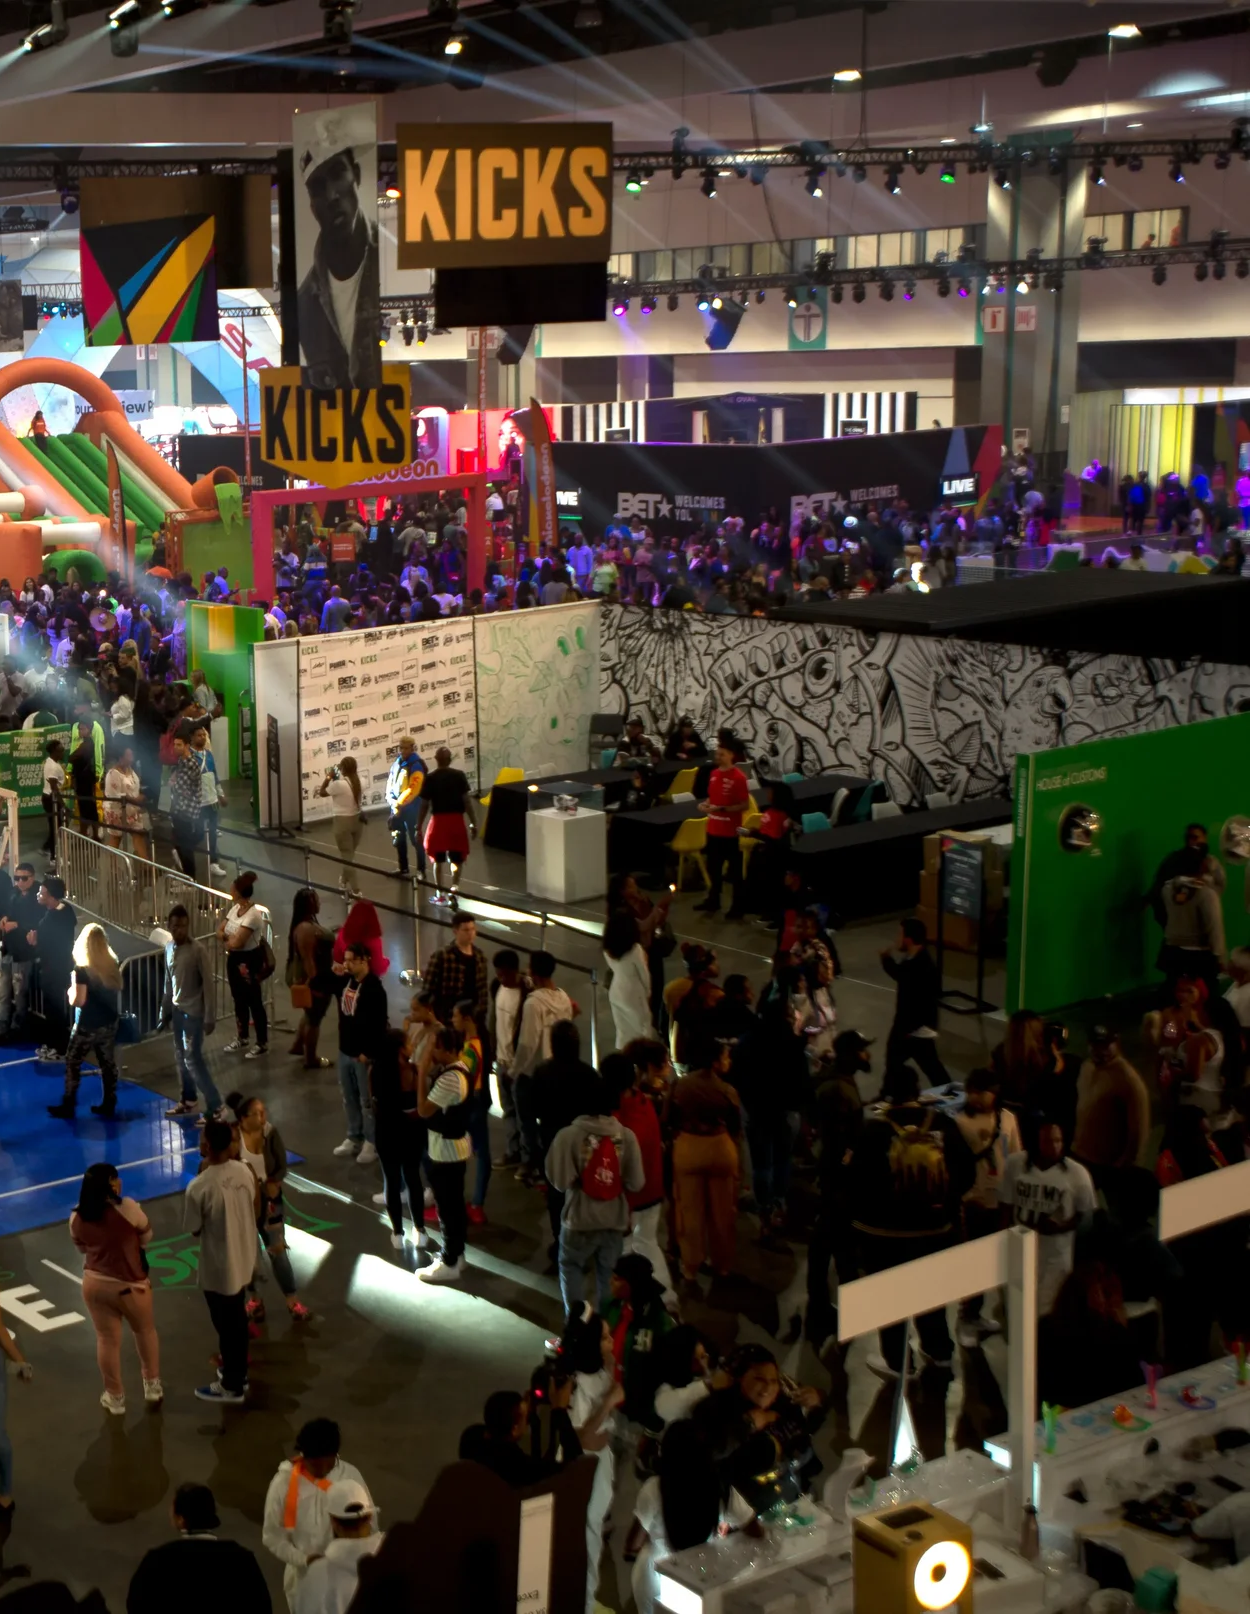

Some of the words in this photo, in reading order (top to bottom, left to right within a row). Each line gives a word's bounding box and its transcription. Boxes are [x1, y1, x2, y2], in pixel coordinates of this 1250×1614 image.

[405, 147, 607, 242] KICKS
[264, 384, 405, 464] KICKS
[942, 477, 976, 495] LIVE
[850, 484, 900, 502] WELCOMES
[618, 492, 663, 519] BET
[675, 495, 726, 509] WELCOMES
[421, 636, 437, 647] BET
[338, 675, 353, 686] BET
[397, 683, 413, 693] BET
[443, 691, 459, 702] BET
[327, 739, 343, 750] BET
[12, 750, 42, 758] WANTED
[16, 771, 43, 780] FORCE
[19, 778, 41, 787] ONES
